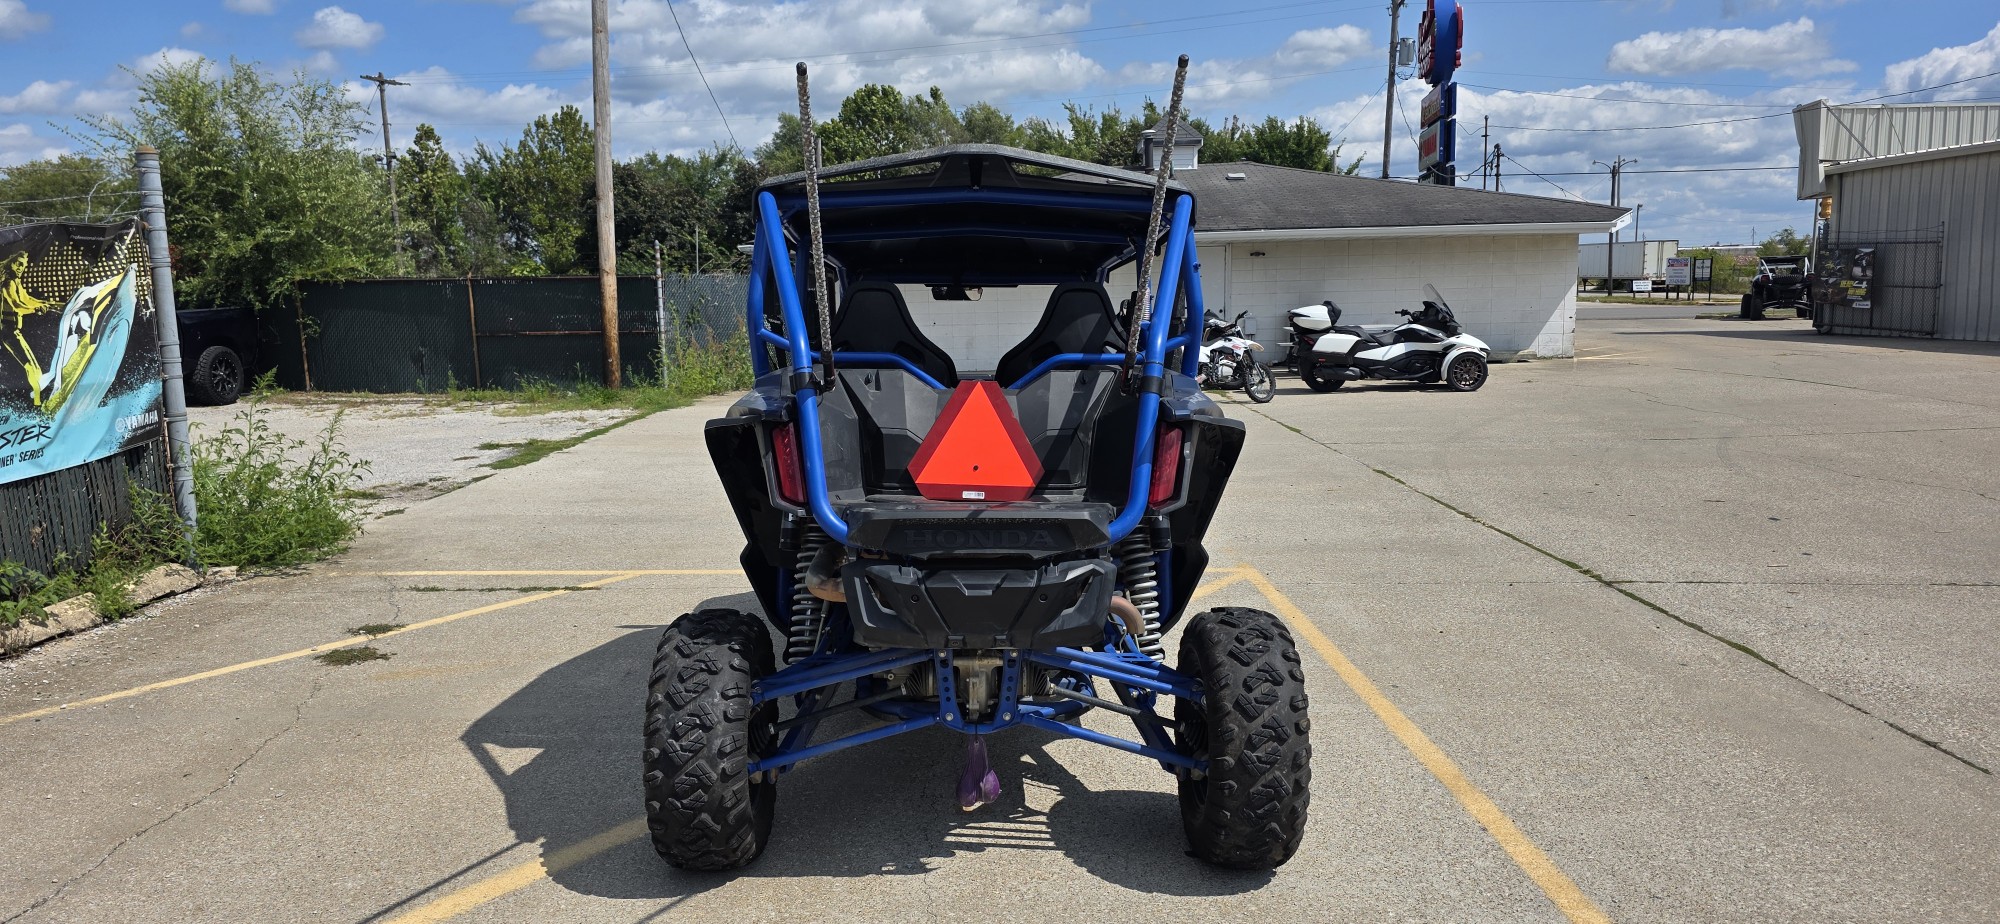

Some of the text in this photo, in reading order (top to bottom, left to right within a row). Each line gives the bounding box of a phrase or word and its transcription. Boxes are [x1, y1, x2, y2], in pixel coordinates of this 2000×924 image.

[125, 410, 159, 430] YAMAHA
[0, 423, 52, 450] STER
[19, 447, 46, 463] SERIES
[904, 529, 1058, 548] HONDA
